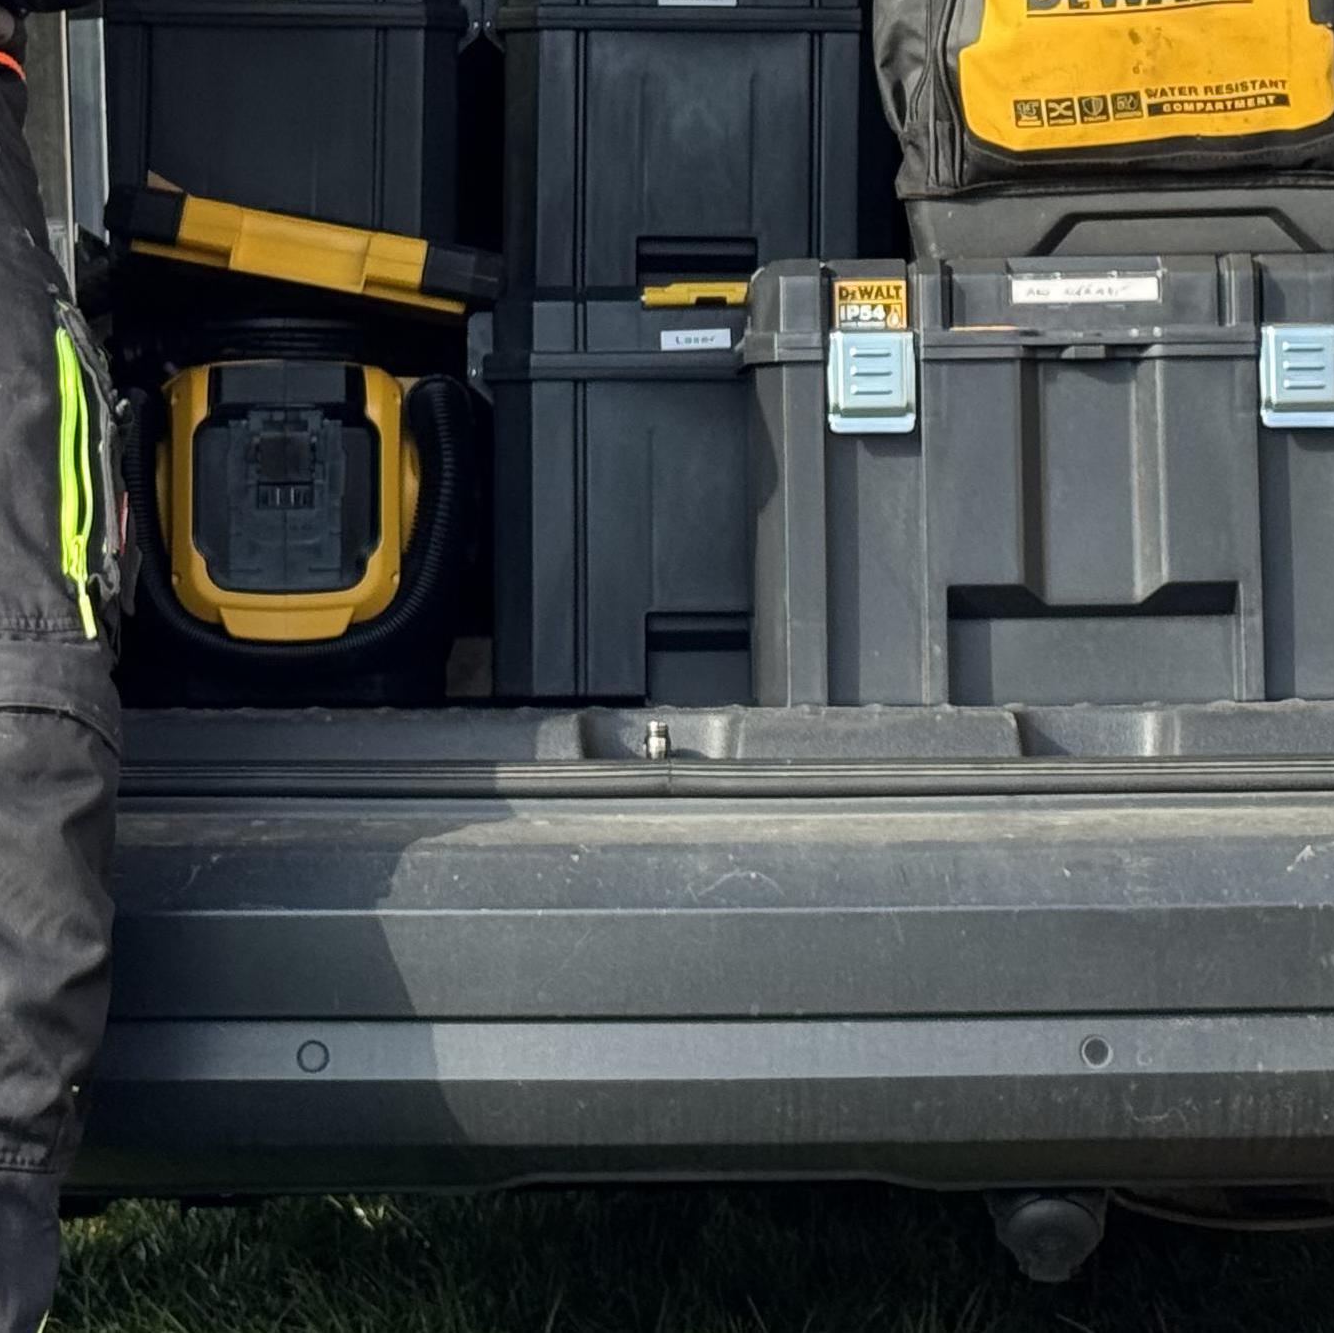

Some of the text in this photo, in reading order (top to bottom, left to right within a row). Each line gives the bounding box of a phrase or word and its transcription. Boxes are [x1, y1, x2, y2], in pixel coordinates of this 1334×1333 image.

[1144, 79, 1287, 99] WATER RESISTANT
[1162, 95, 1276, 113] COMPARTMENT
